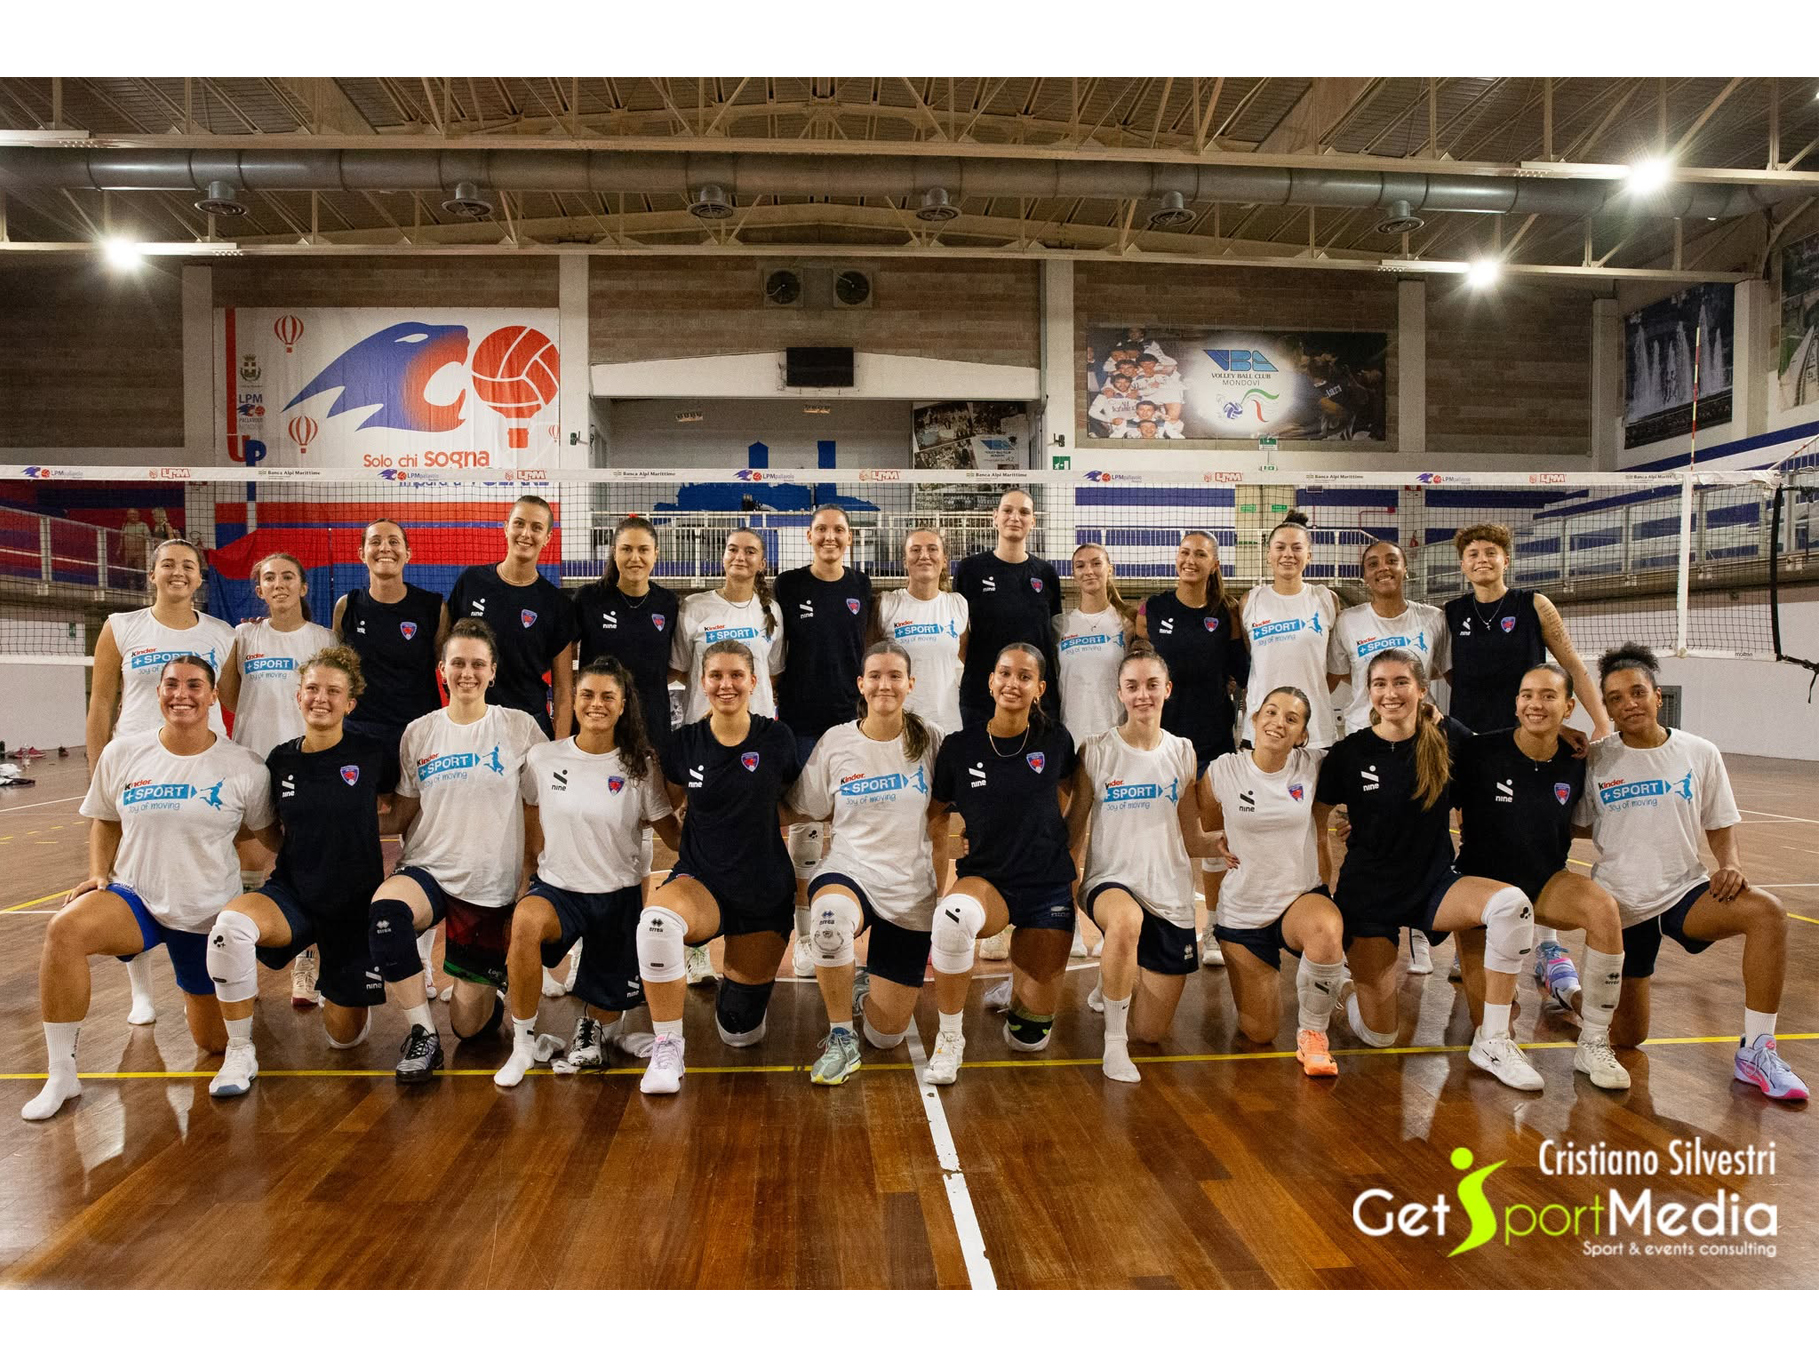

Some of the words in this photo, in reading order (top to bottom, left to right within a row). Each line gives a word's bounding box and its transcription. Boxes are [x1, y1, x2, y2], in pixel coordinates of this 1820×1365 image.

[239, 394, 262, 403] LPM
[363, 454, 393, 468] Solo
[398, 454, 418, 468] chi
[424, 451, 490, 468] sogna
[161, 468, 190, 479] LPM
[517, 470, 546, 481] LPM
[871, 471, 899, 482] LPM
[1215, 472, 1243, 482] LPM
[1540, 474, 1566, 484] LPM
[800, 611, 814, 619] nine
[442, 771, 468, 780] moving
[551, 784, 567, 792] nine
[971, 779, 987, 788] nine
[1363, 783, 1380, 791] nine
[1495, 795, 1513, 803] nine
[1632, 798, 1658, 807] moving
[151, 802, 180, 811] moving
[1128, 802, 1150, 810] moving
[366, 982, 382, 990] nine
